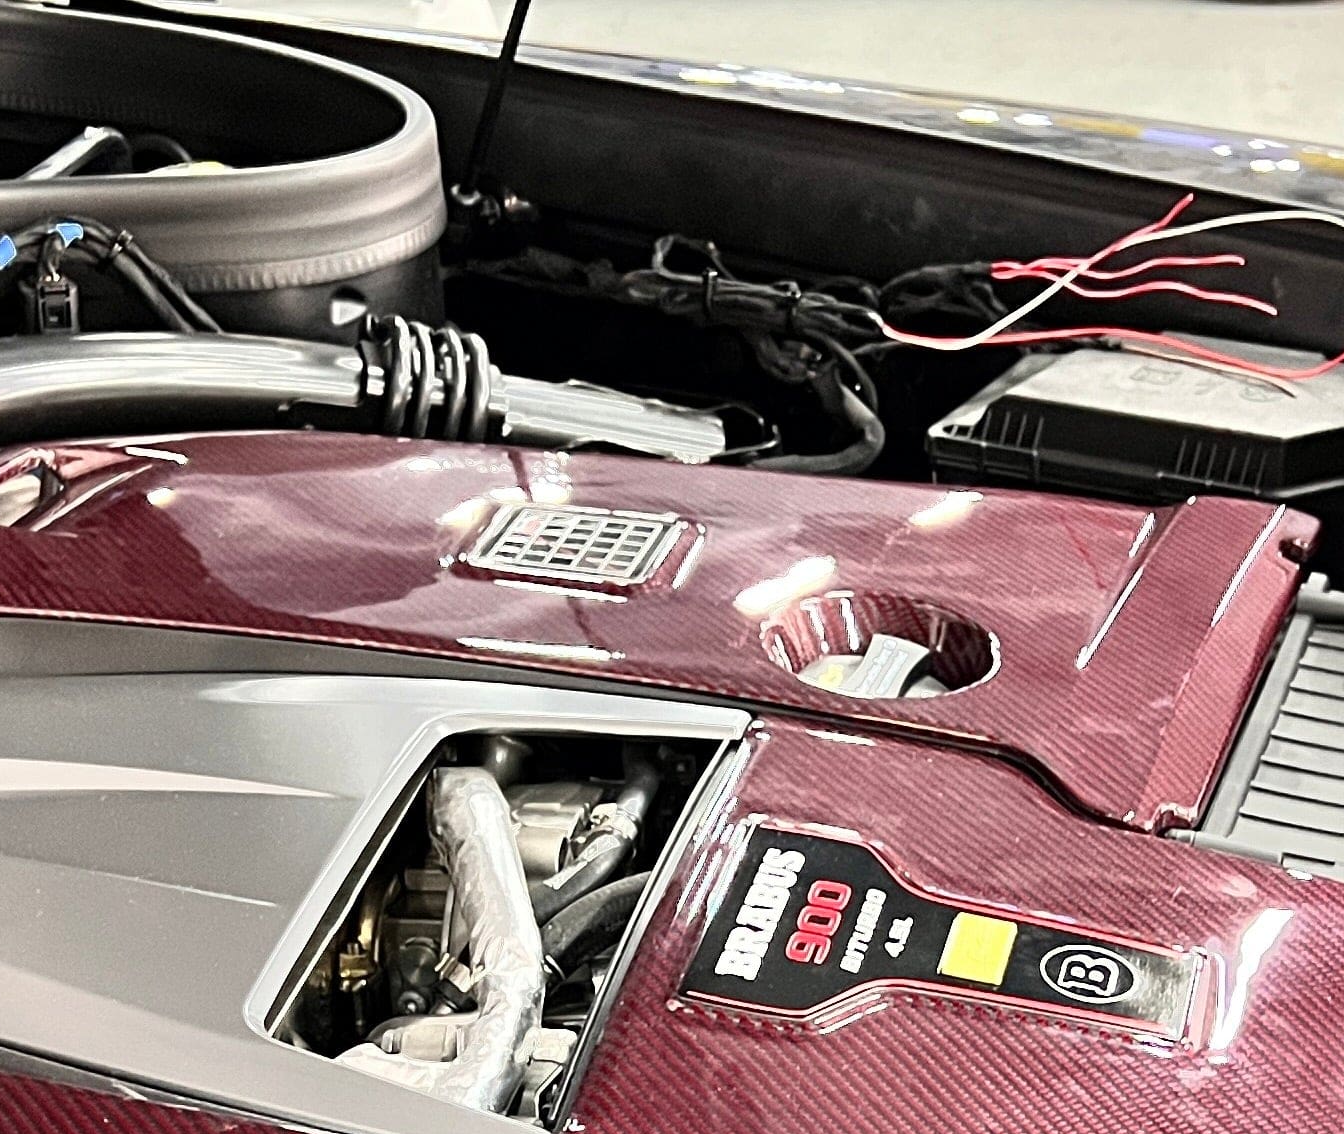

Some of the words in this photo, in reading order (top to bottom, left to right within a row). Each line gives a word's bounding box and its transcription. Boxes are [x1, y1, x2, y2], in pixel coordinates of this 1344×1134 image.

[715, 848, 805, 981] BRABUS
[786, 880, 852, 964] 900
[840, 888, 887, 973] BITURBO
[1056, 953, 1120, 997] B
